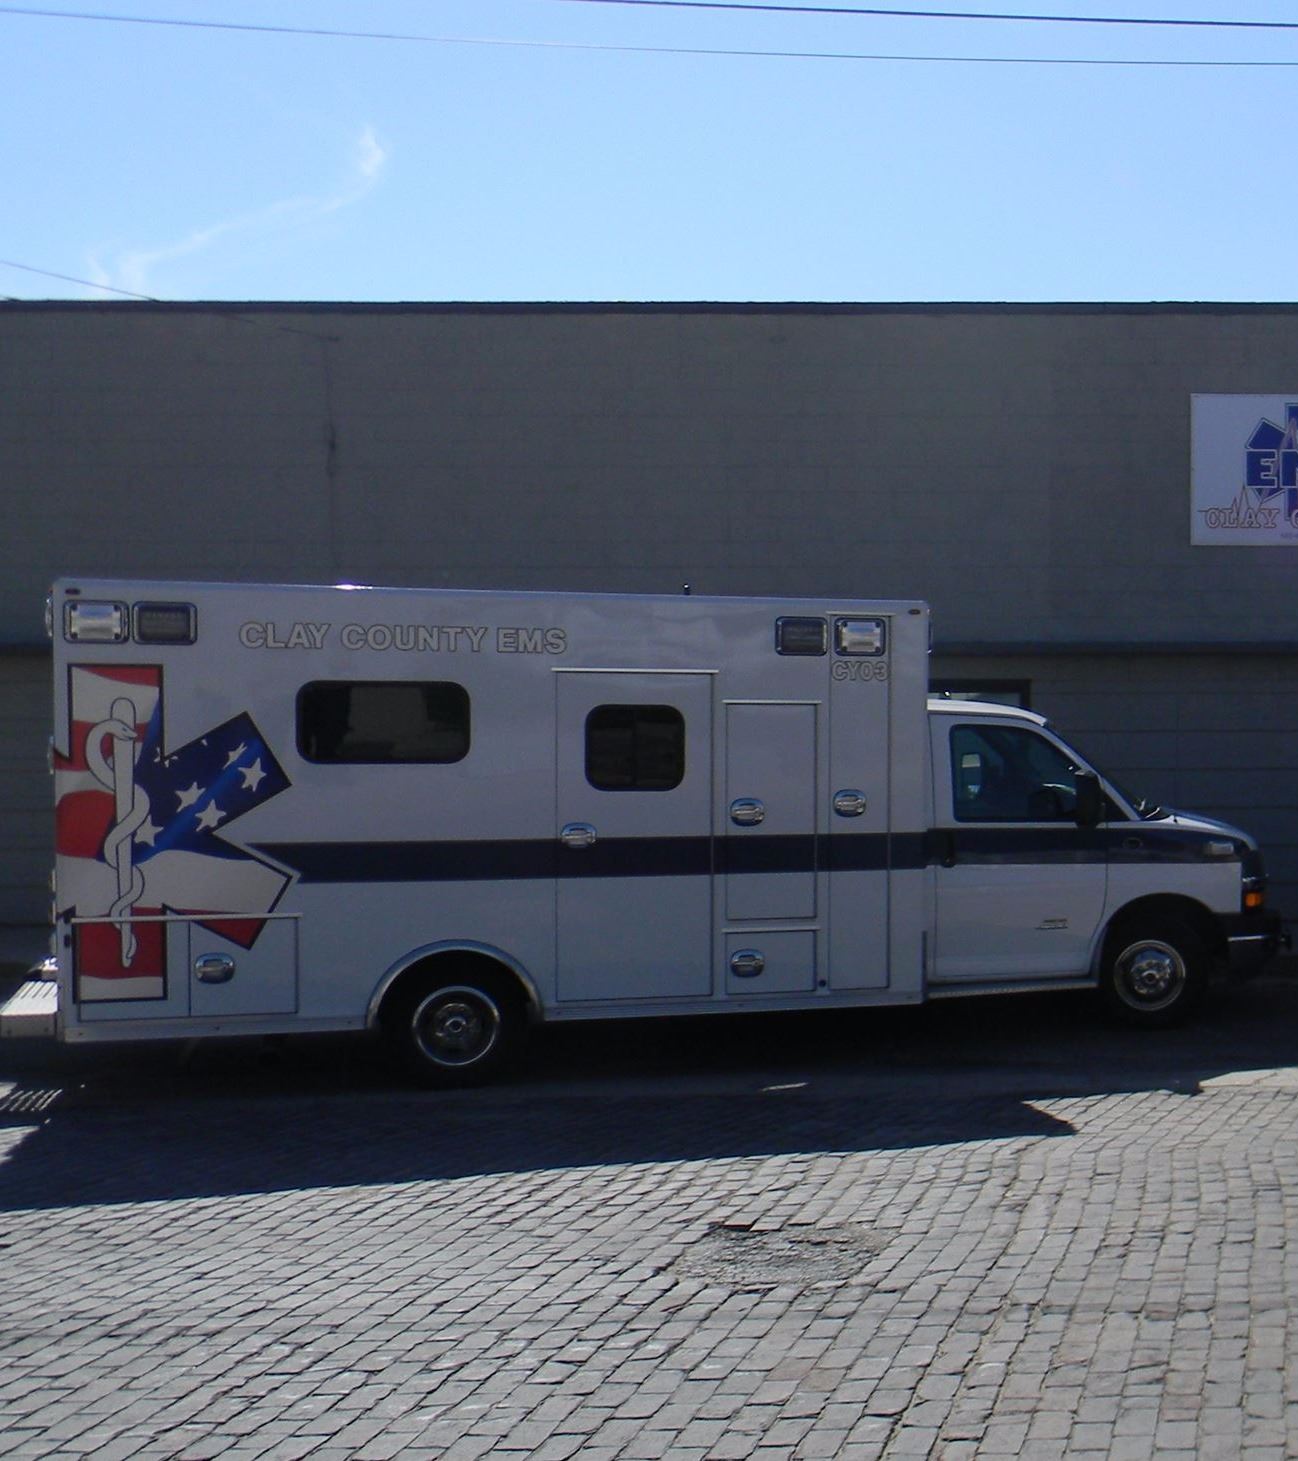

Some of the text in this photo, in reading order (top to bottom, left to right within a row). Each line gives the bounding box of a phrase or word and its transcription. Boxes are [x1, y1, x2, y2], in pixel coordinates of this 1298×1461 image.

[1206, 508, 1279, 529] CLAY
[239, 622, 567, 654] CLAY COUNTY EMS
[832, 660, 889, 681] CY03
